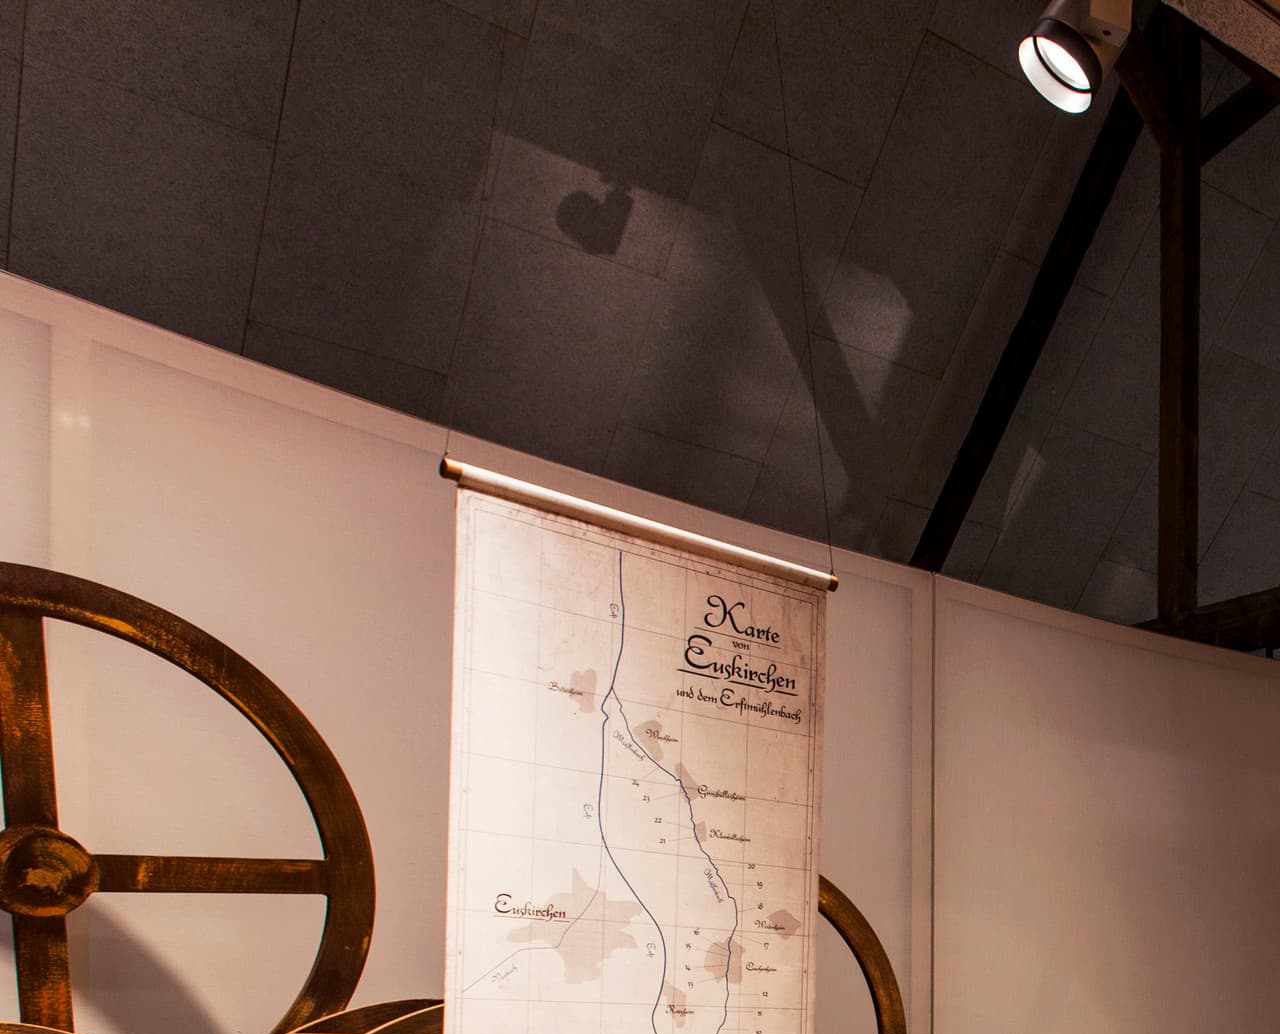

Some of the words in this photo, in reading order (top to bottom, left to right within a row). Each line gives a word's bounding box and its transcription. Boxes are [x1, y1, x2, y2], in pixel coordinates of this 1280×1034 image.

[703, 594, 781, 643] Karte
[684, 634, 796, 693] Euskirchen
[732, 640, 750, 650] von
[676, 686, 695, 699] und
[697, 688, 718, 704] dem
[719, 688, 801, 725] Erftmühlenbach
[494, 893, 566, 923] Euskirchen
